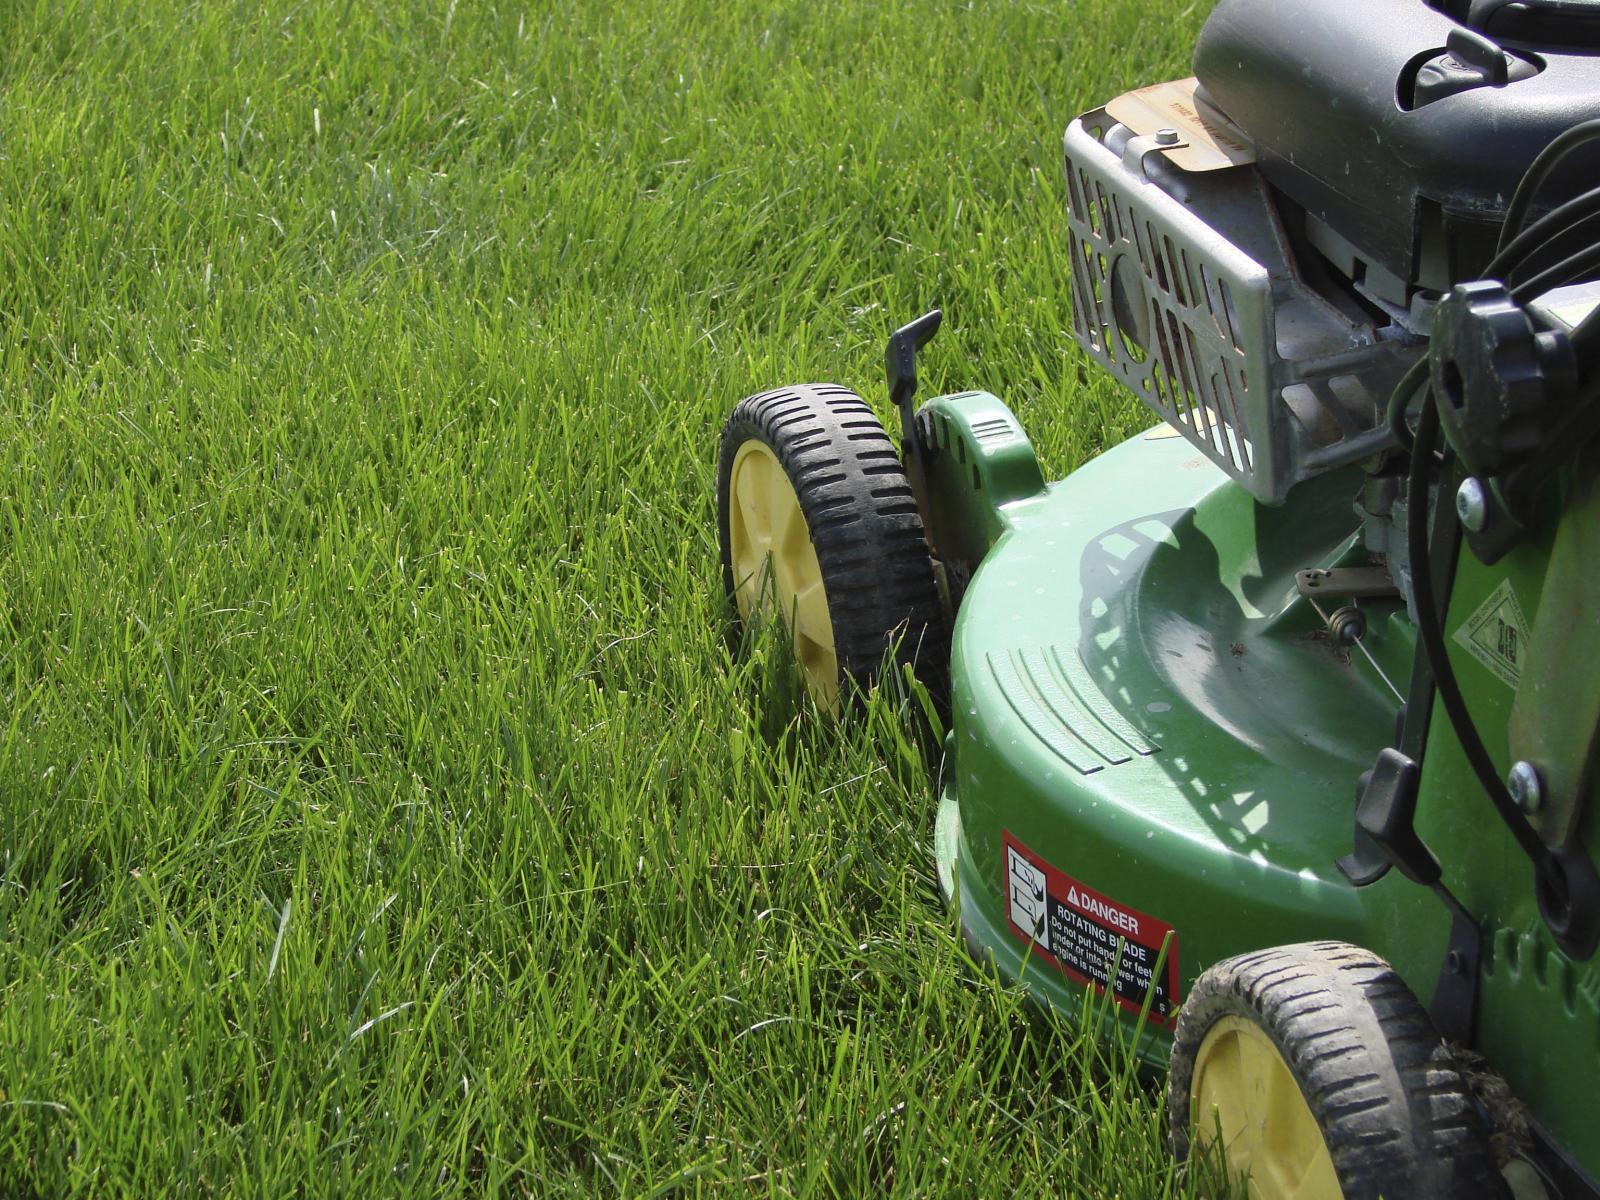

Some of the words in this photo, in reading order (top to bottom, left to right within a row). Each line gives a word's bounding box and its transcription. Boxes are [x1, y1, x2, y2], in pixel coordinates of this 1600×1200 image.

[1058, 905, 1106, 942] ROTATING
[1081, 893, 1138, 934] DANGER
[1051, 915, 1062, 930] Do
[1064, 926, 1076, 940] not
[1078, 935, 1091, 948] put
[1093, 941, 1117, 963] hand
[1122, 957, 1132, 969] or
[1134, 962, 1152, 978] feet
[1080, 960, 1087, 970] is
[1075, 944, 1084, 956] or
[1086, 948, 1102, 966] into
[1104, 961, 1134, 983] mwer
[1136, 977, 1162, 995] whn
